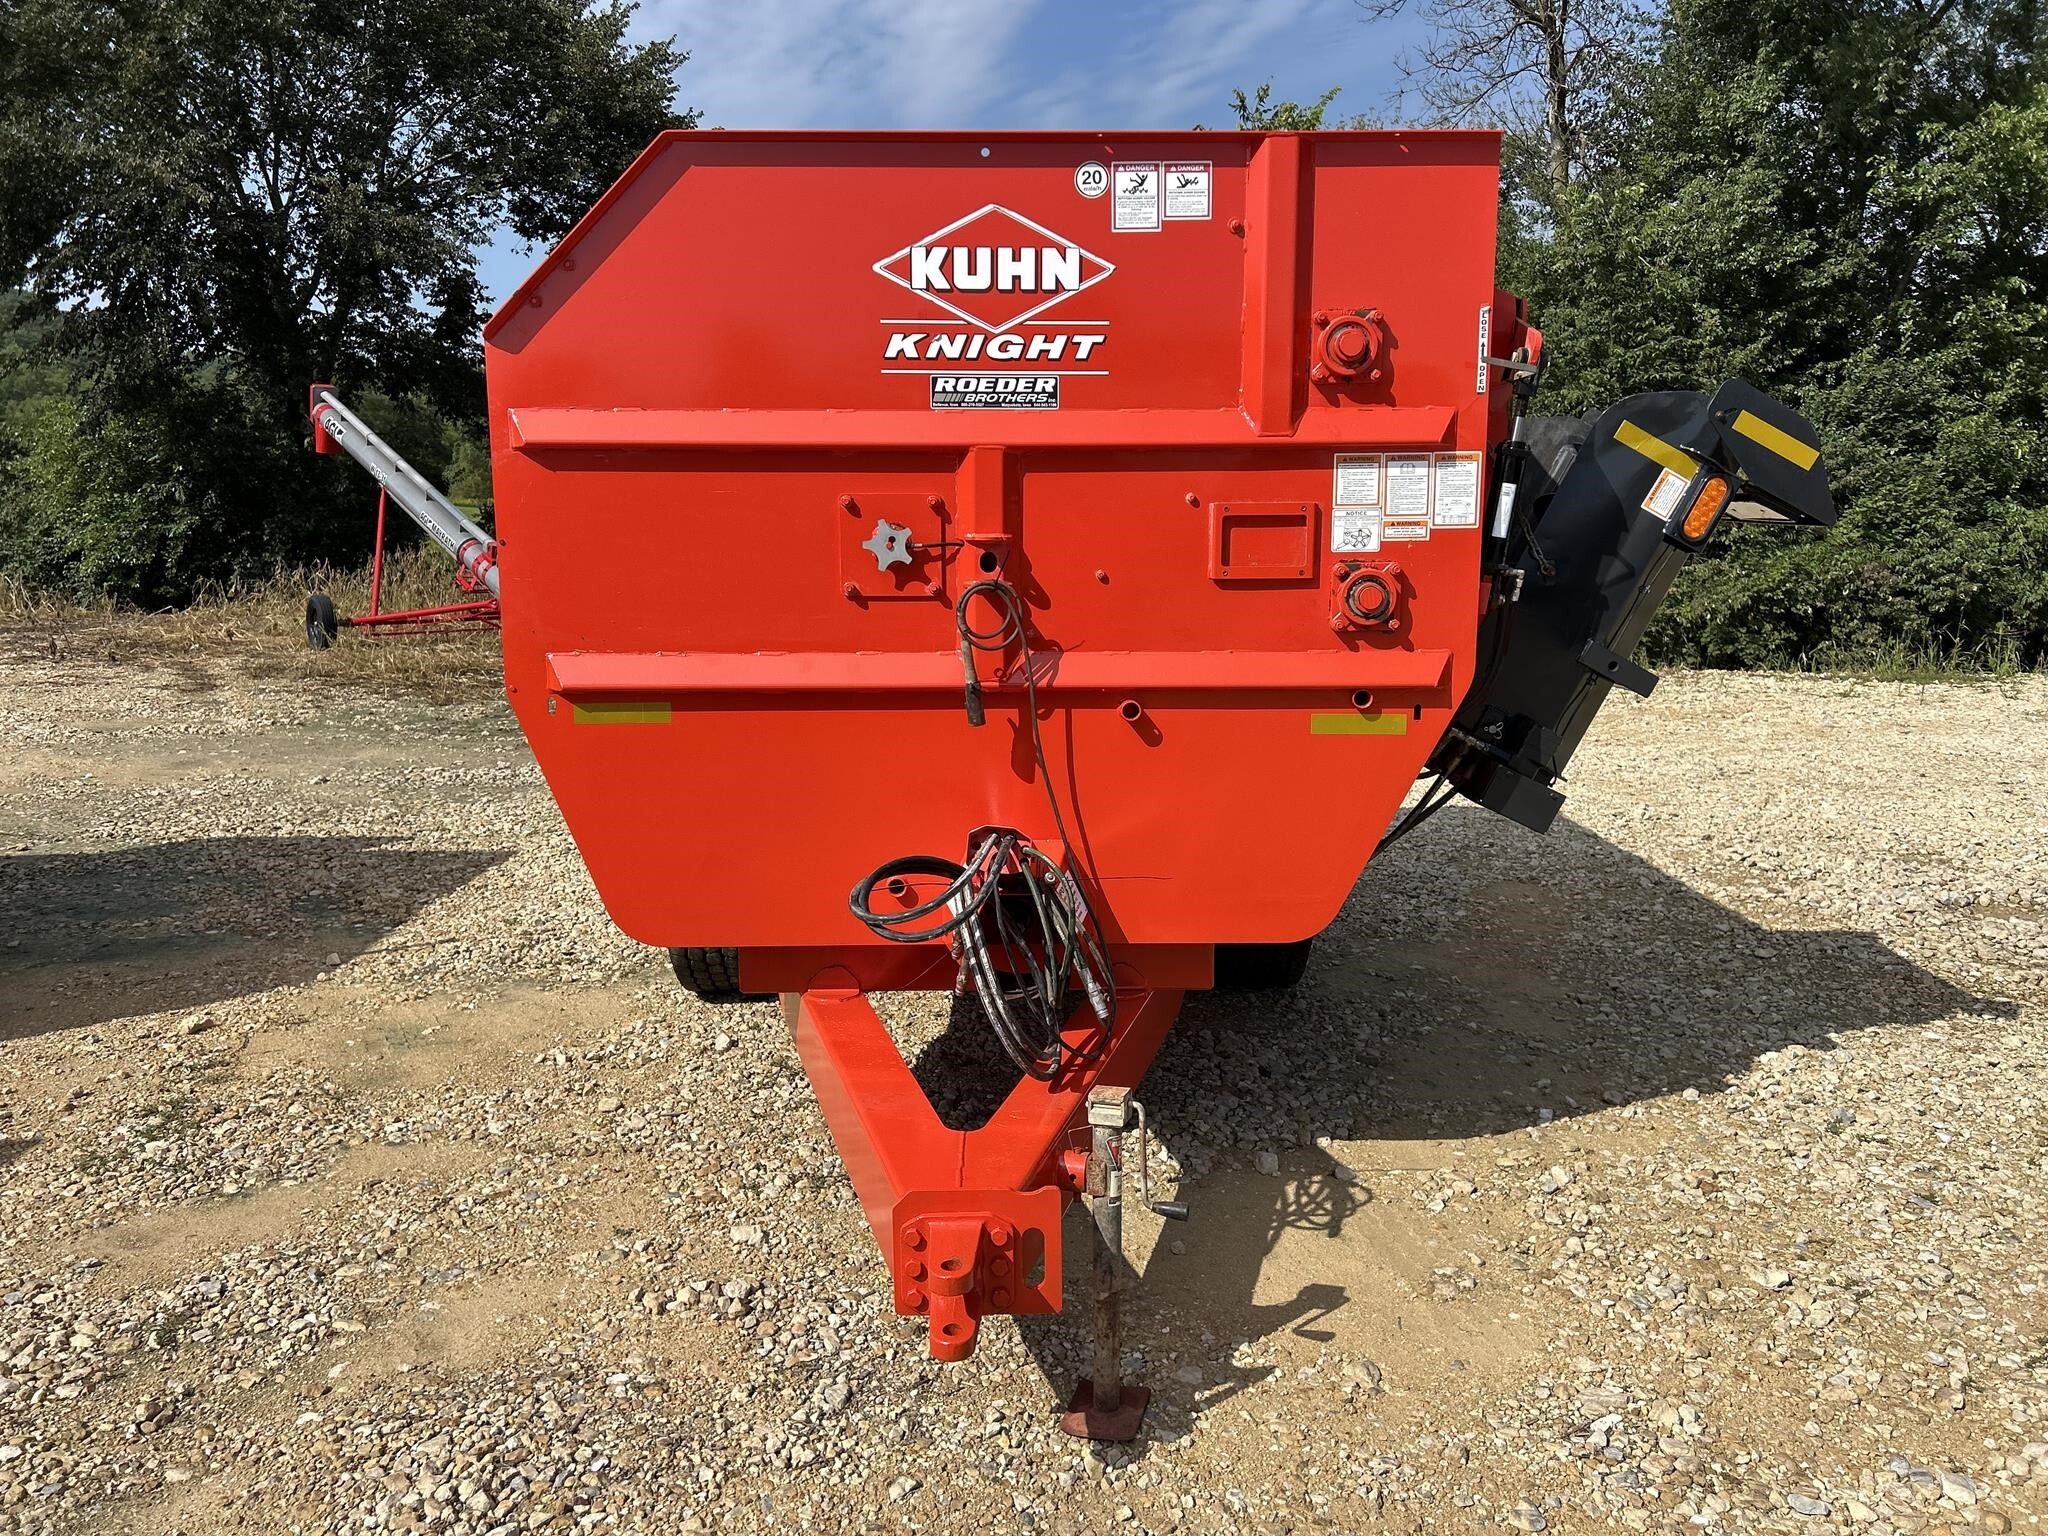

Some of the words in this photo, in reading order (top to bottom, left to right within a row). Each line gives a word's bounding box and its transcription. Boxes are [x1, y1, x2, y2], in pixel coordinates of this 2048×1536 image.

[1125, 164, 1155, 172] DANGER
[1177, 164, 1205, 172] DANGER
[1082, 170, 1103, 185] 20
[910, 246, 1081, 293] KUHN
[883, 332, 1108, 362] KNIGHT
[934, 377, 1056, 393] ROEDER
[1478, 365, 1486, 391] OPEN
[964, 393, 1048, 403] BROTHERS
